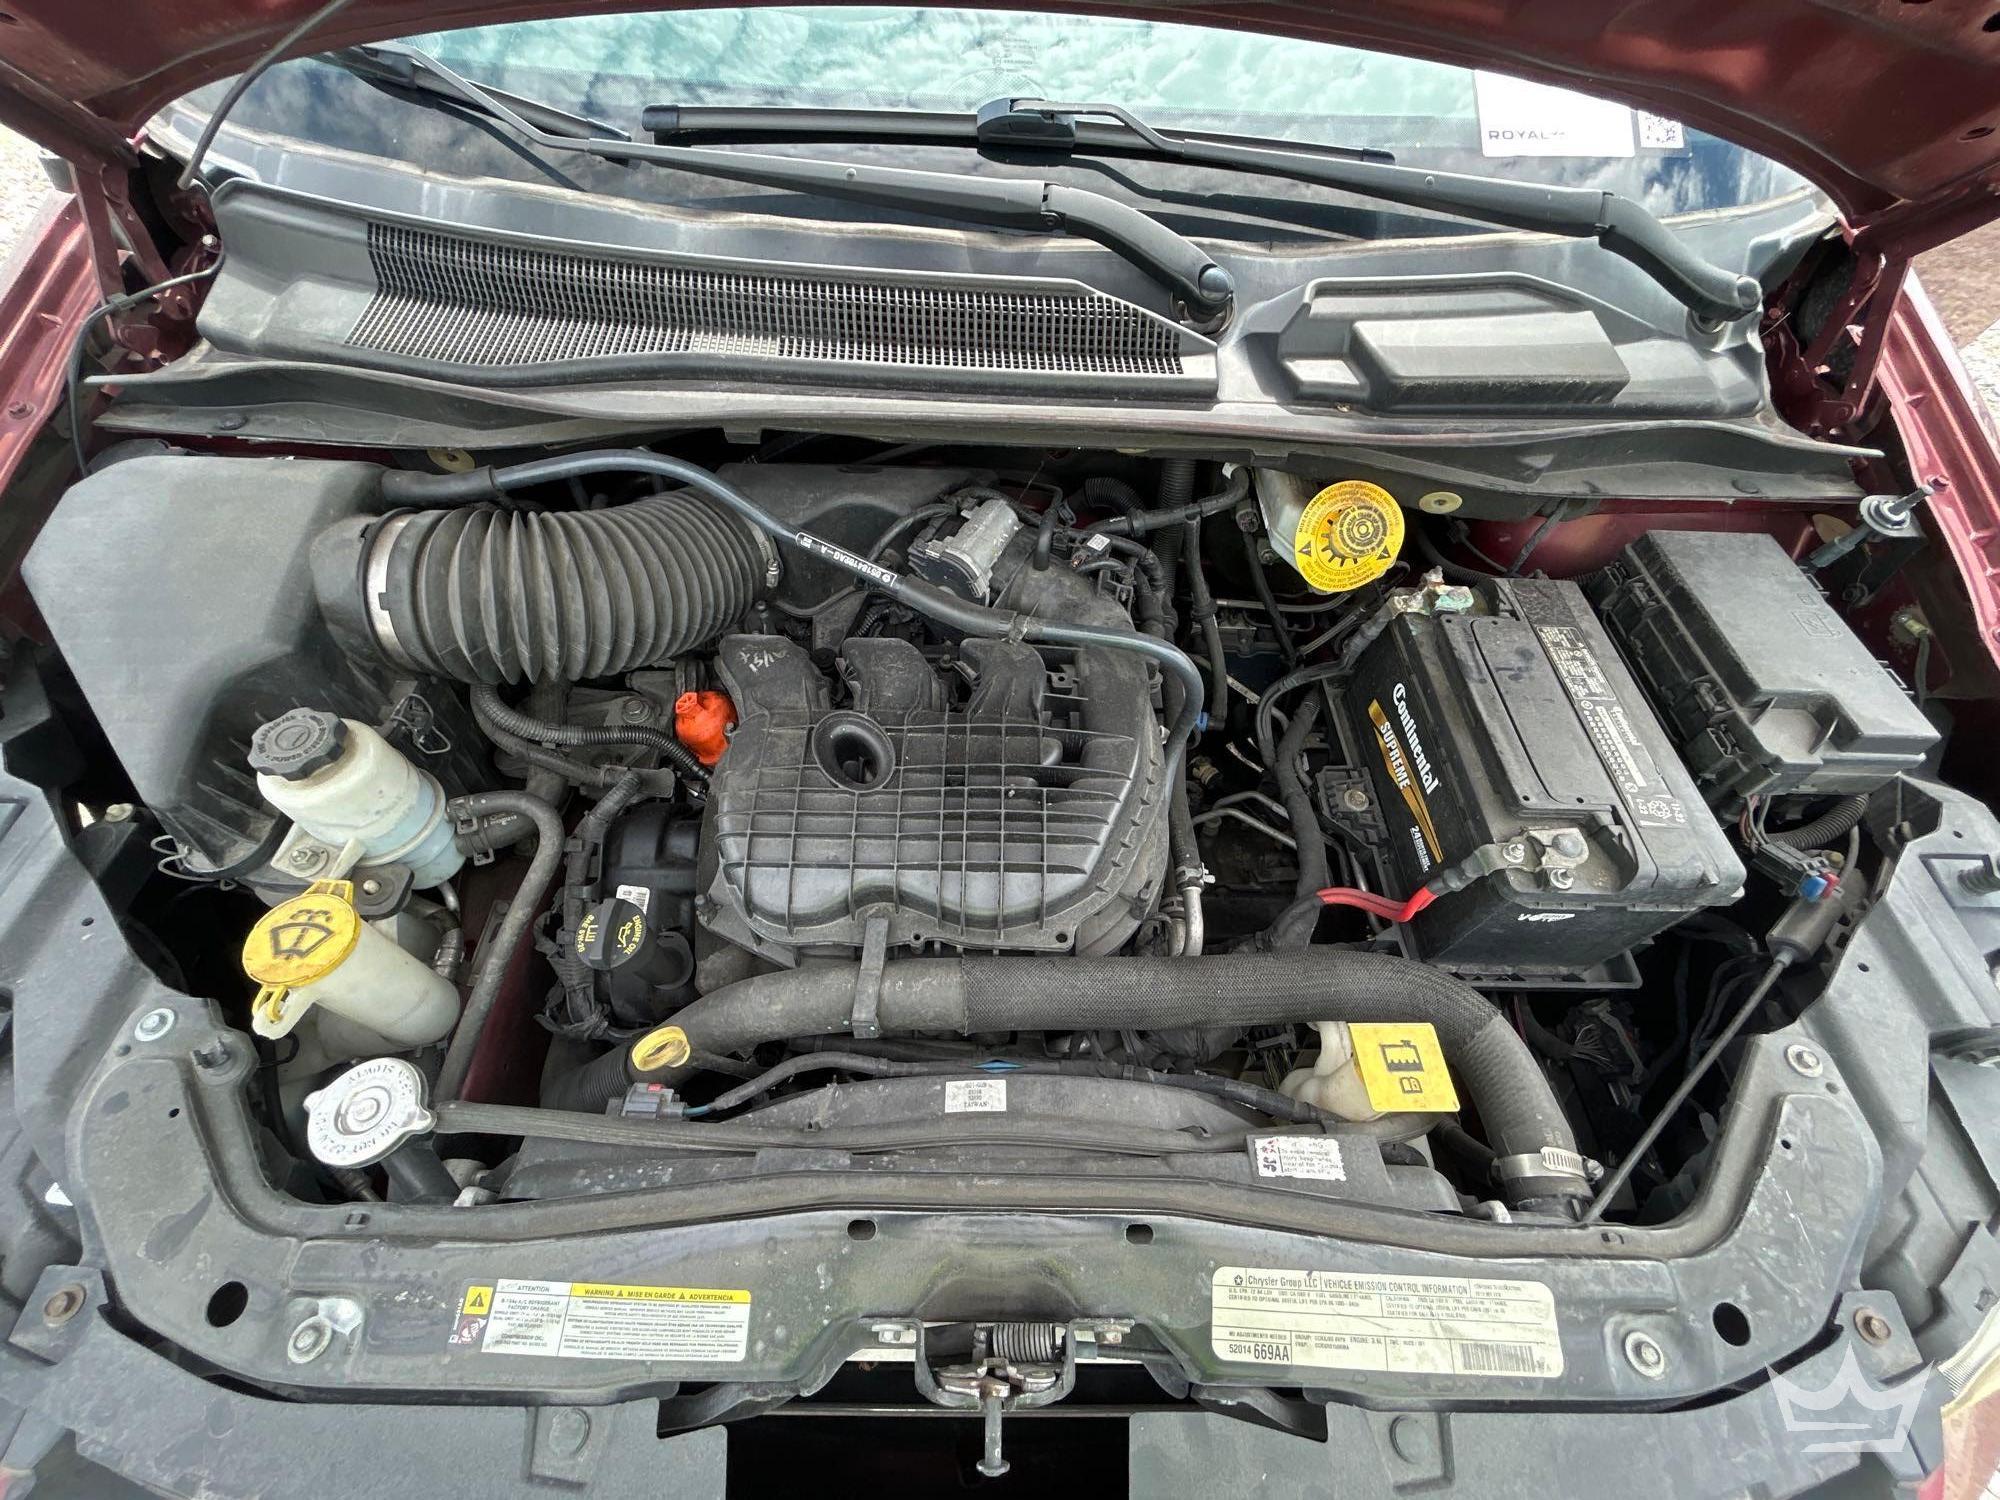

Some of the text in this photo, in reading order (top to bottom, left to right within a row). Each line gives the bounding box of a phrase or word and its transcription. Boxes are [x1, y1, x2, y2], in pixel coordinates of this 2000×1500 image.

[1488, 130, 1551, 140] ROYAL
[1393, 683, 1440, 795] Continental
[1380, 721, 1412, 790] SUPREME
[1410, 825, 1421, 839] 24
[582, 915, 595, 929] SAE
[623, 915, 642, 955] ENGINE OIL
[1248, 1275, 1278, 1287] Chrysler
[1280, 1276, 1303, 1289] Group
[1304, 1278, 1318, 1288] LLC
[1323, 1279, 1353, 1290] VEHICLE
[1354, 1280, 1387, 1291] EMISSION
[1388, 1281, 1420, 1293] CONTROL
[1421, 1283, 1468, 1295] INFORMATION
[1229, 1343, 1290, 1361] 52014 669AA
